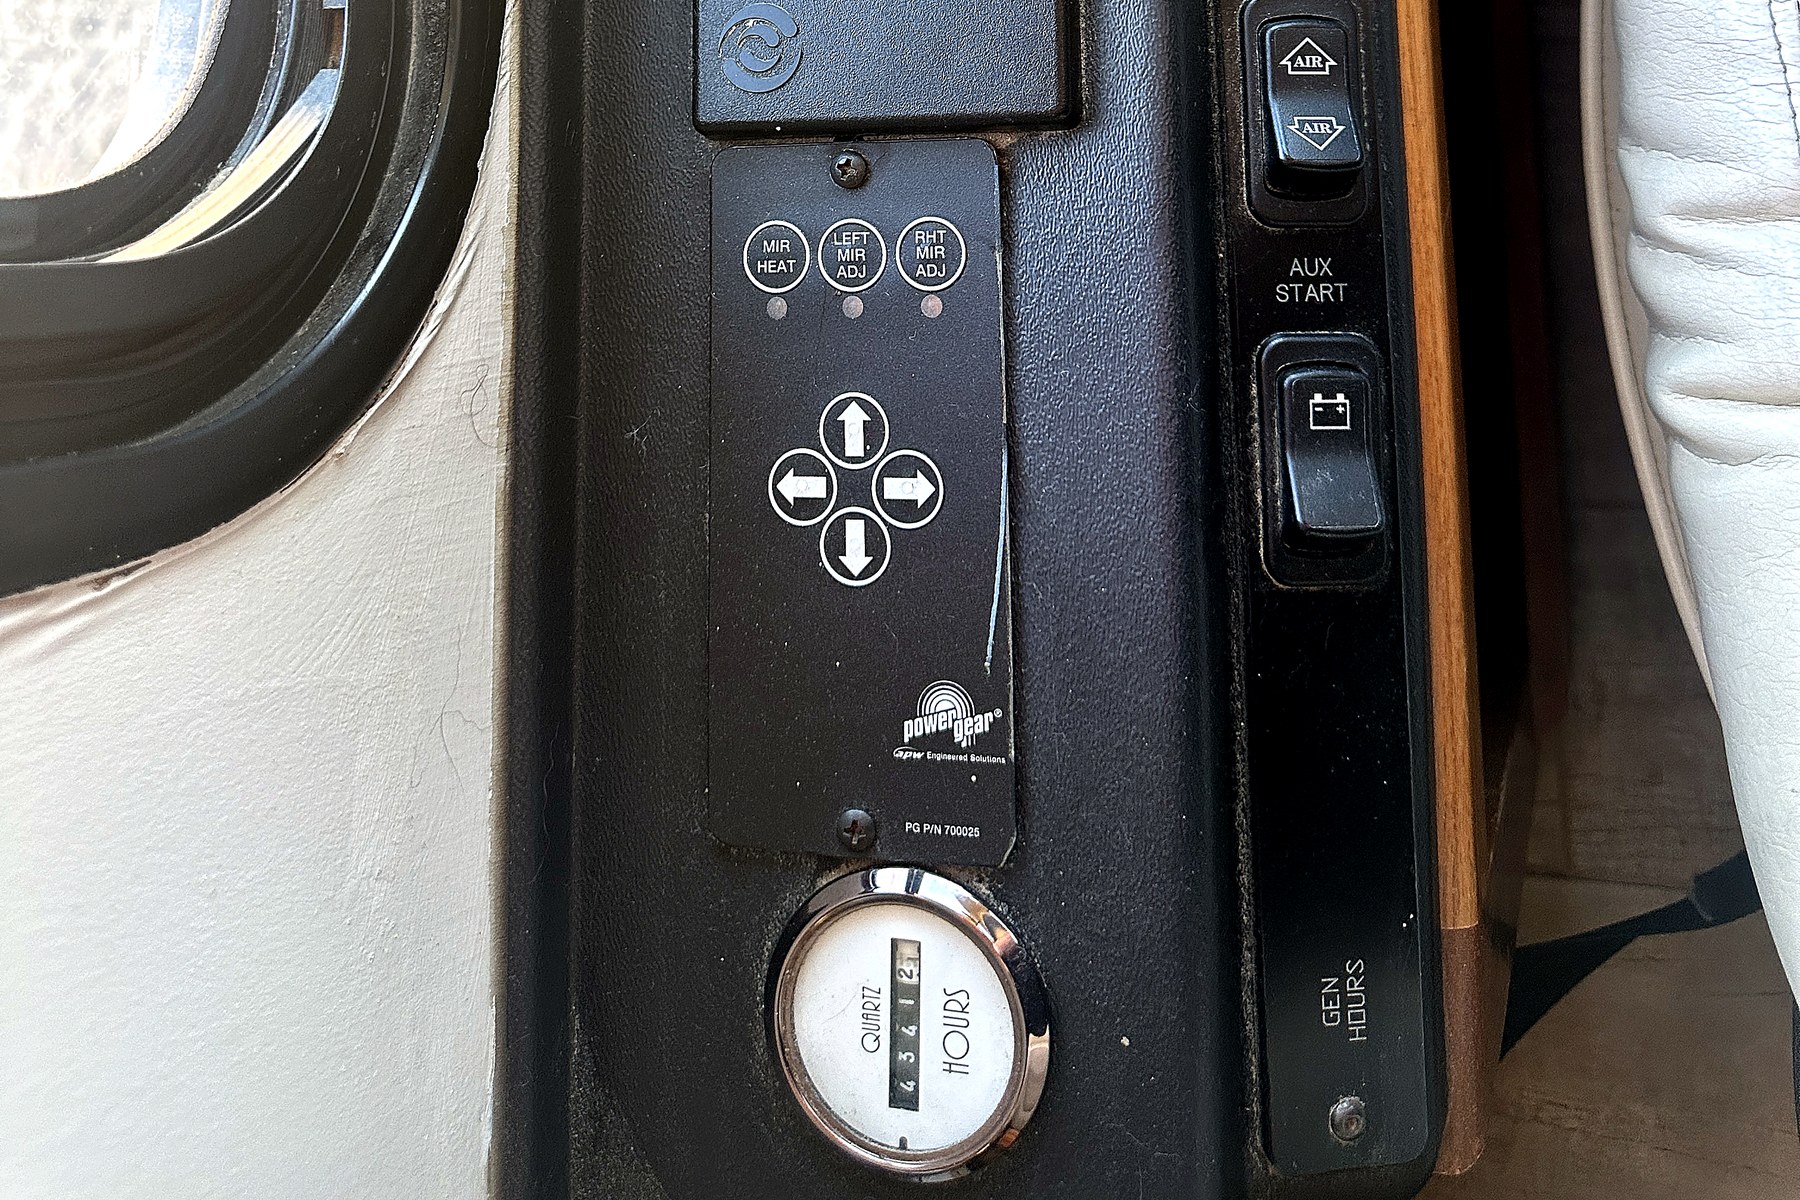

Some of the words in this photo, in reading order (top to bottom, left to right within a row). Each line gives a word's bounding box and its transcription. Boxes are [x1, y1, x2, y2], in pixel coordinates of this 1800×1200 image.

[1293, 55, 1323, 69] AIR
[1303, 121, 1333, 134] AIR
[833, 232, 870, 246] LEFT
[915, 230, 946, 244] RHT
[763, 240, 790, 253] MIR
[916, 247, 945, 260] MIR
[837, 248, 866, 262] MIR
[757, 260, 796, 274] HEAT
[836, 265, 867, 279] ADJ
[915, 264, 946, 278] ADJ
[1290, 257, 1333, 277] AUX
[1275, 283, 1347, 303] START
[926, 751, 968, 762] Engineered
[970, 754, 1006, 764] Solutions
[905, 821, 920, 833] PG
[923, 823, 942, 835] P/N
[944, 825, 980, 837] 700025
[1321, 977, 1340, 1026] GEN
[1346, 959, 1367, 1041] HOURS
[861, 986, 881, 1053] QUARTZ
[943, 988, 970, 1075] HOURS
